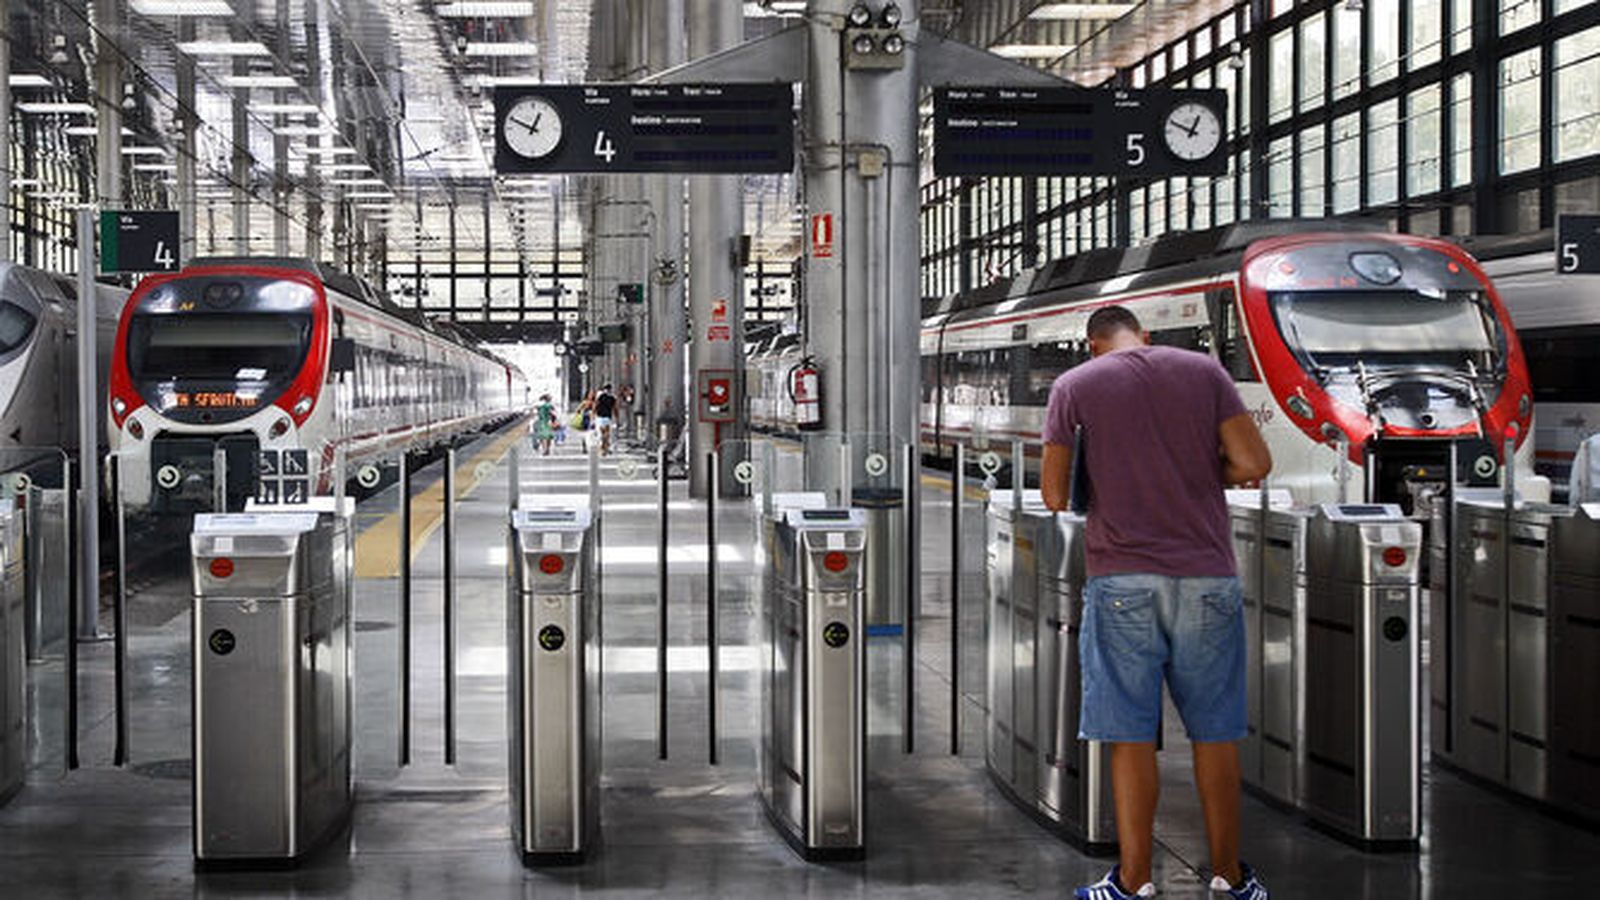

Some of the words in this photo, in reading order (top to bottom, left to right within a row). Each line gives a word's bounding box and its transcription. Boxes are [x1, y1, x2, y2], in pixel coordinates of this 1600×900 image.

[594, 131, 616, 163] 4
[1126, 133, 1145, 166] 5
[154, 240, 175, 270] 4
[1562, 242, 1579, 272] 5
